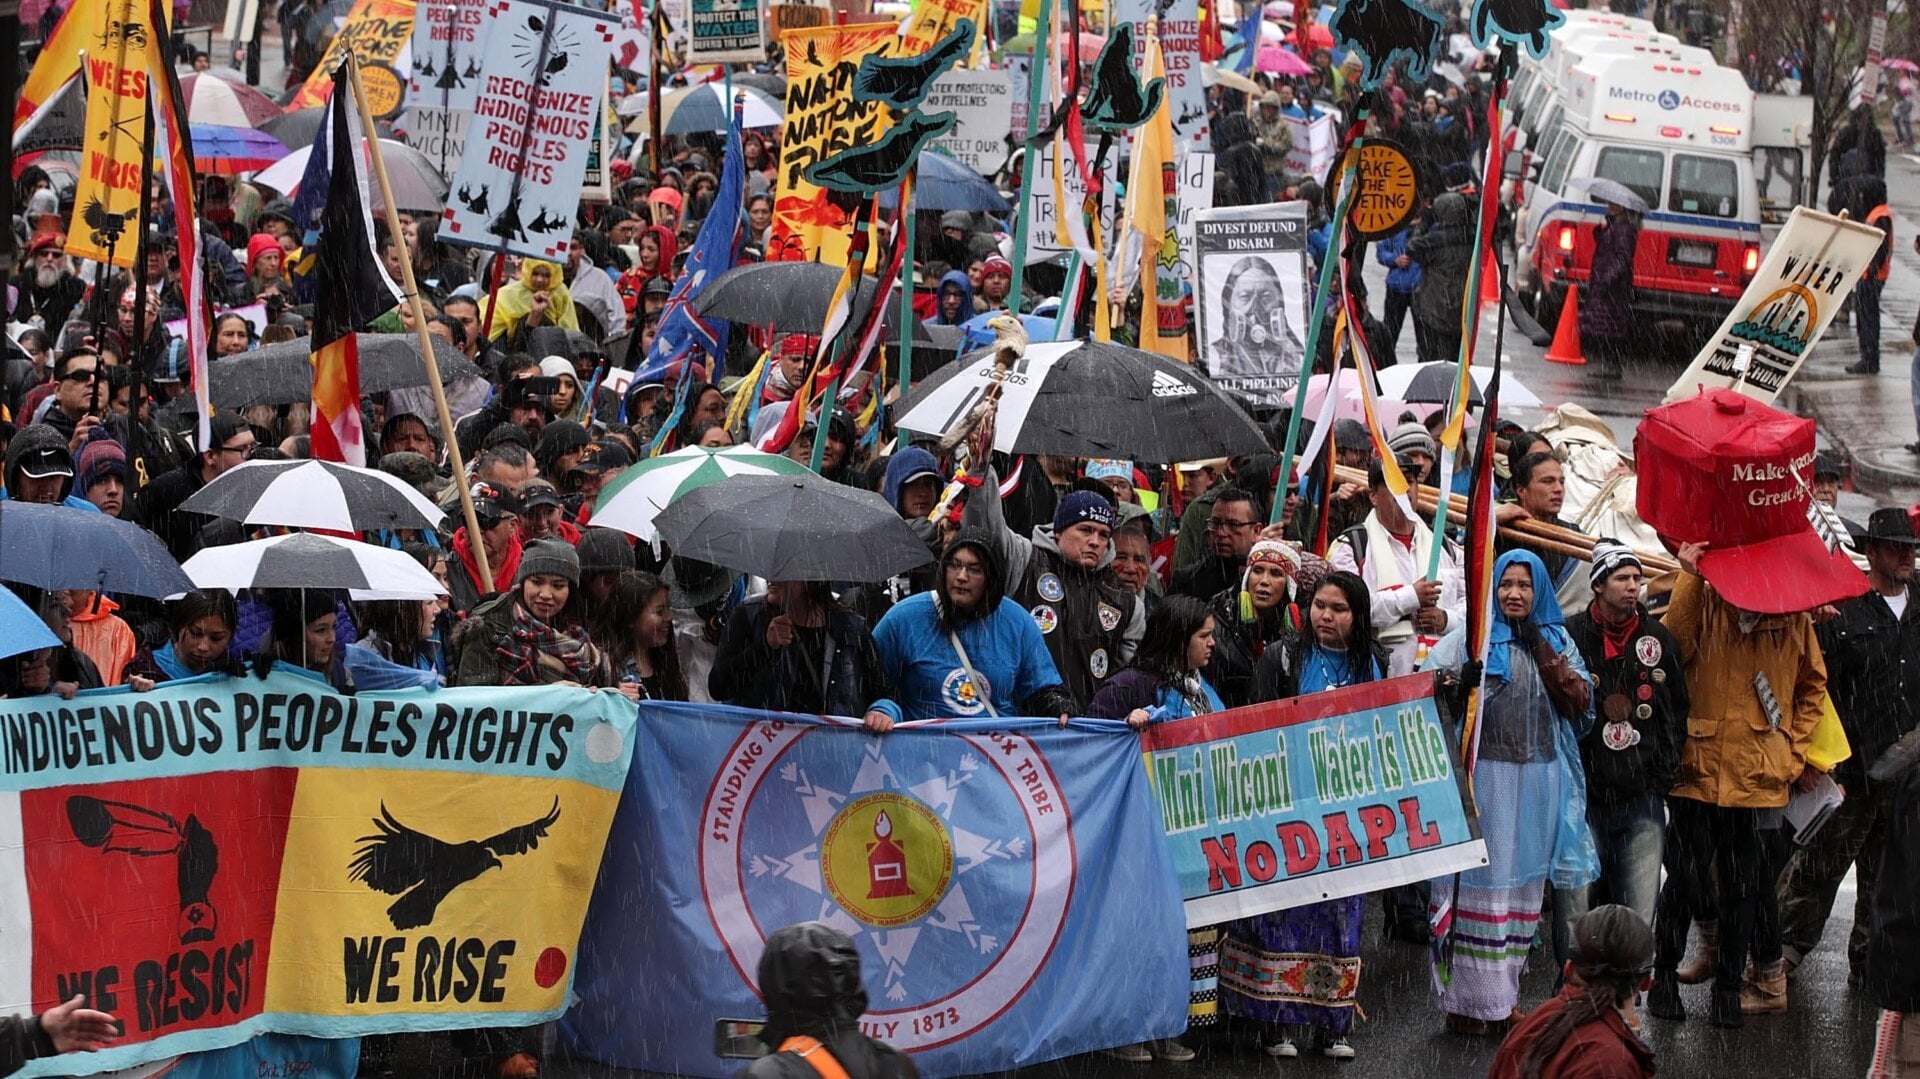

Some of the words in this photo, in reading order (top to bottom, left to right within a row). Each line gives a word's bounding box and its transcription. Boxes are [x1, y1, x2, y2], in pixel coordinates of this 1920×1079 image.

[695, 12, 735, 23] PROTECT
[741, 10, 757, 21] THE
[430, 26, 476, 42] RIGHTS
[695, 21, 758, 36] WATER
[364, 84, 398, 102] OMEN
[486, 75, 593, 116] RECOGNIZE
[928, 83, 954, 94] ATER
[955, 83, 1007, 95] PROTECTORS
[1609, 86, 1656, 103] Metro
[927, 96, 939, 106] NO
[941, 95, 988, 107] PIPELINES
[1681, 95, 1742, 113] Access
[417, 110, 461, 133] MNI
[474, 95, 590, 140] INDIGENOUS
[485, 121, 568, 161] PEOPLES
[975, 140, 1000, 154] OUR
[1711, 135, 1737, 145] 5306
[488, 146, 554, 185] RIGHTS
[1360, 193, 1406, 209] ETING
[1203, 223, 1248, 235] DIVEST
[1248, 221, 1297, 233] DEFUND
[1227, 237, 1275, 250] DISARM
[1151, 383, 1198, 397] adidas
[1217, 379, 1241, 391] ALL
[1732, 463, 1786, 481] Make
[1748, 487, 1792, 507] Great
[2, 702, 223, 774] INDIGENOUS
[234, 693, 422, 754] PEOPLES
[425, 705, 575, 771] RIGHTS
[1155, 748, 1208, 836] Mni
[1208, 730, 1294, 825] Wiconi
[1307, 722, 1377, 805] Water
[1372, 713, 1405, 792] is
[1397, 704, 1450, 786] life
[713, 741, 763, 843] STANDING
[760, 719, 796, 743] RO
[1016, 757, 1054, 816] TRIBE
[851, 797, 872, 810] LONG
[871, 793, 902, 802] SOLDIER
[904, 798, 935, 820] CANNON
[932, 816, 945, 834] BALL
[825, 809, 850, 847] PORCUPINE
[343, 936, 407, 1005] WE
[412, 935, 517, 1004] RISE
[57, 962, 120, 1037] WE
[133, 938, 255, 1034] RESIST
[912, 1006, 961, 1035] 1873
